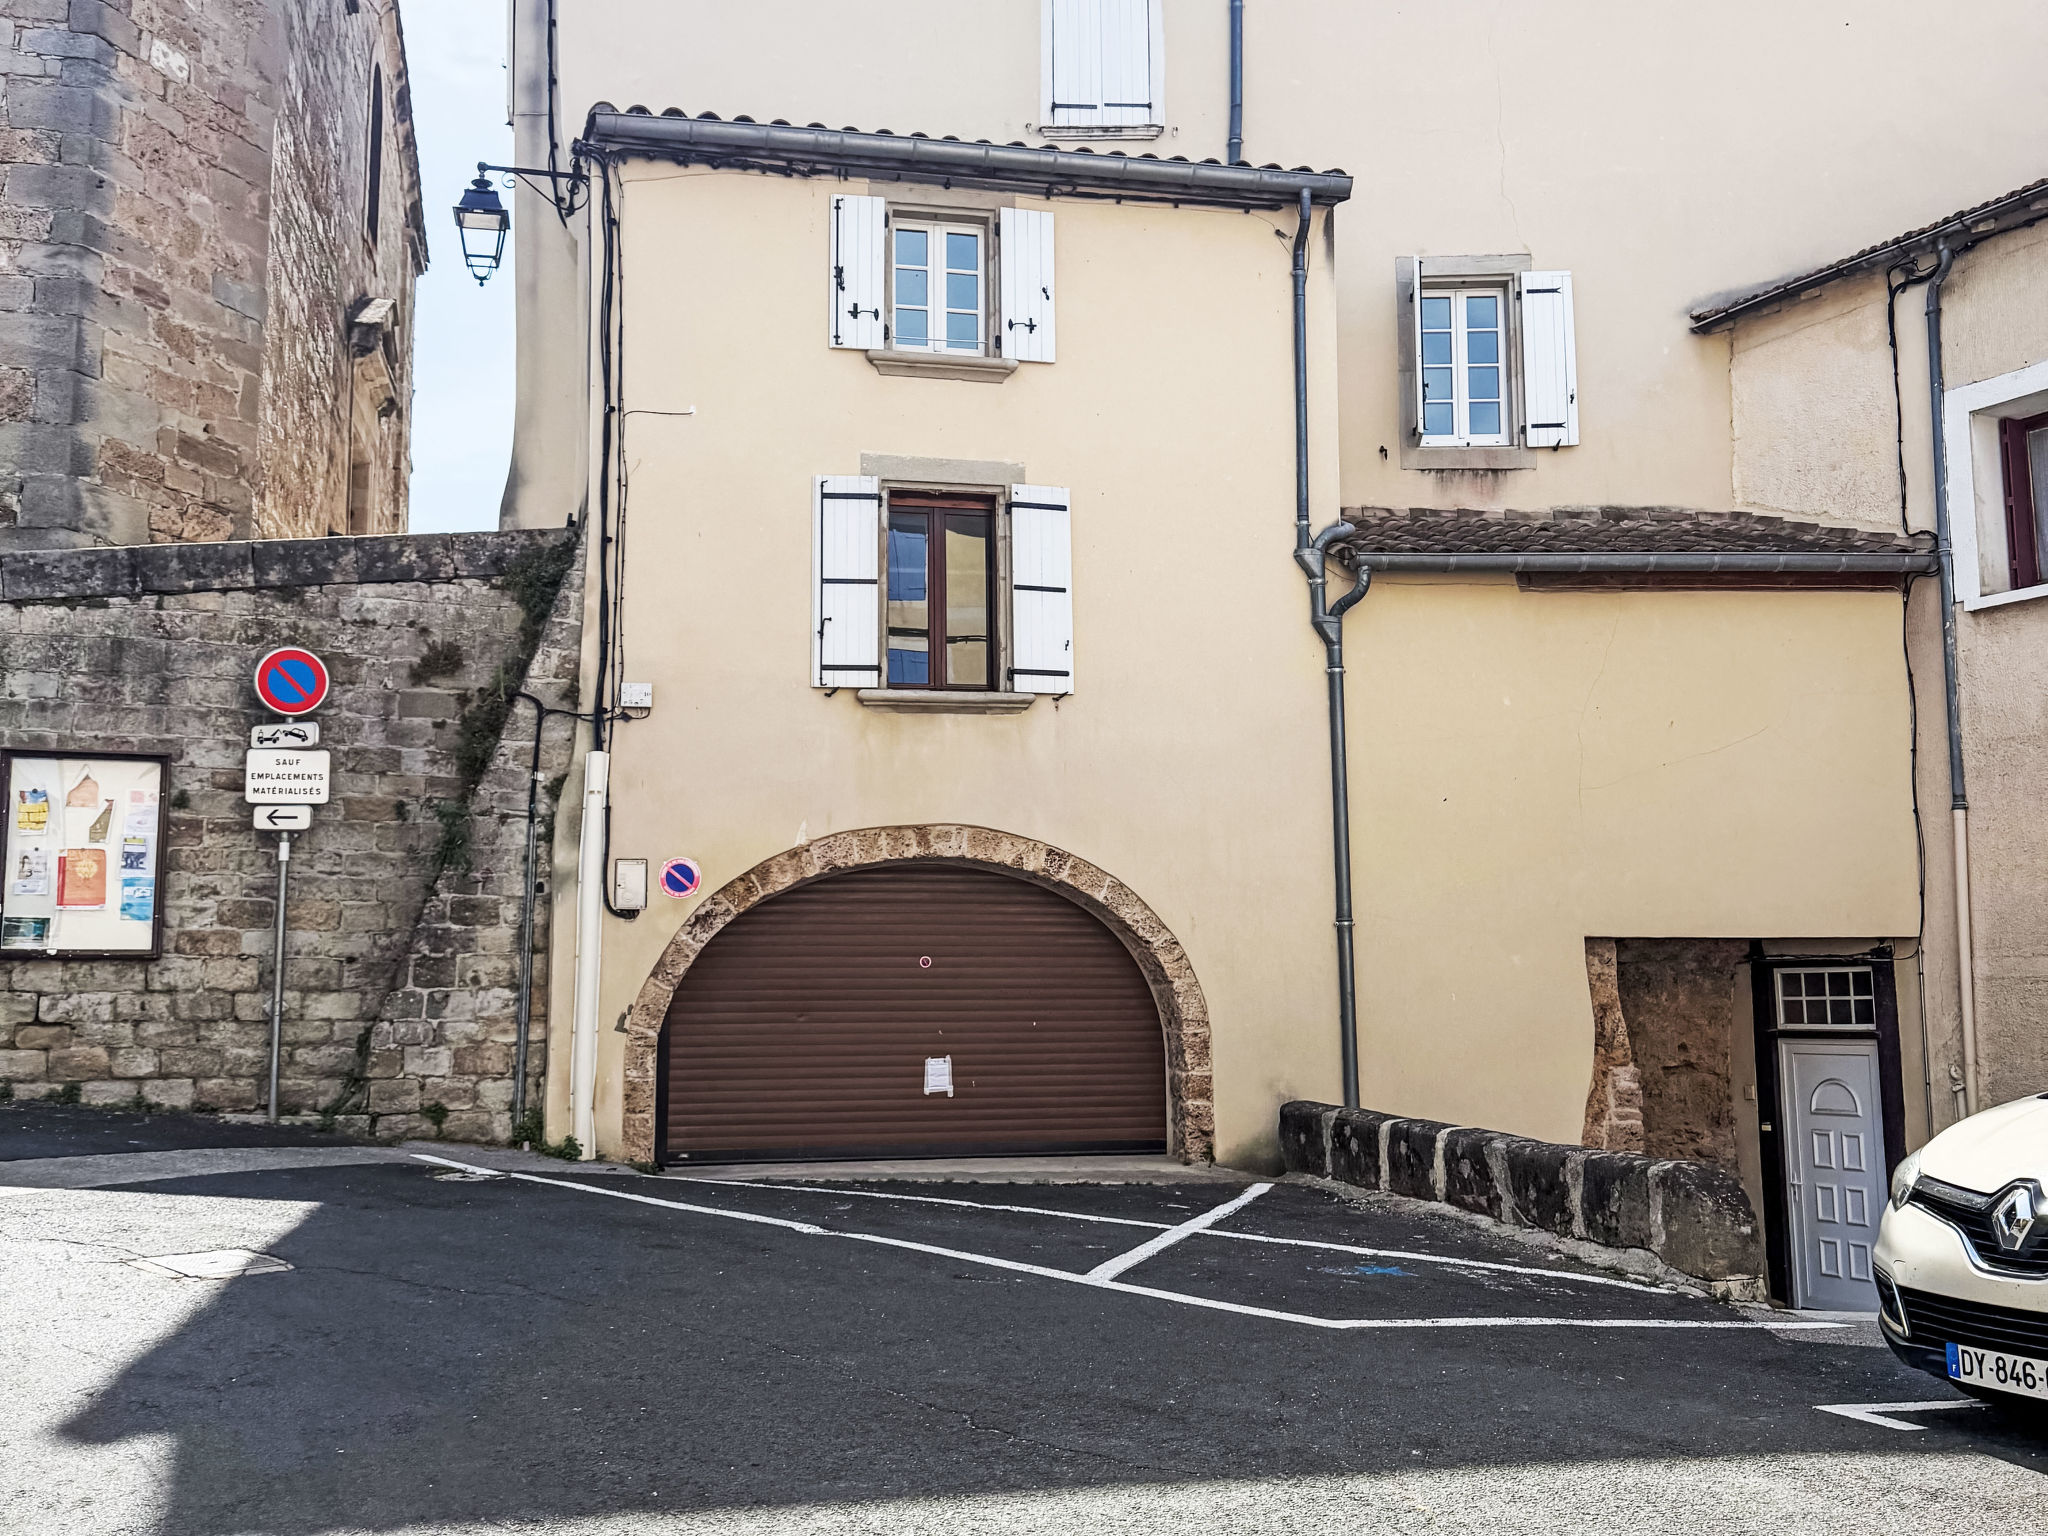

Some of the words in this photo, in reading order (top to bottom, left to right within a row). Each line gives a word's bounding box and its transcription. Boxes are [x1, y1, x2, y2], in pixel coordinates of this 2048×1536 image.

[275, 758, 302, 766] SAUF
[250, 772, 325, 781] EMPLACEMENTS
[252, 786, 322, 796] MATÉRIALISÉS
[1960, 1348, 2048, 1390] DY-846-
